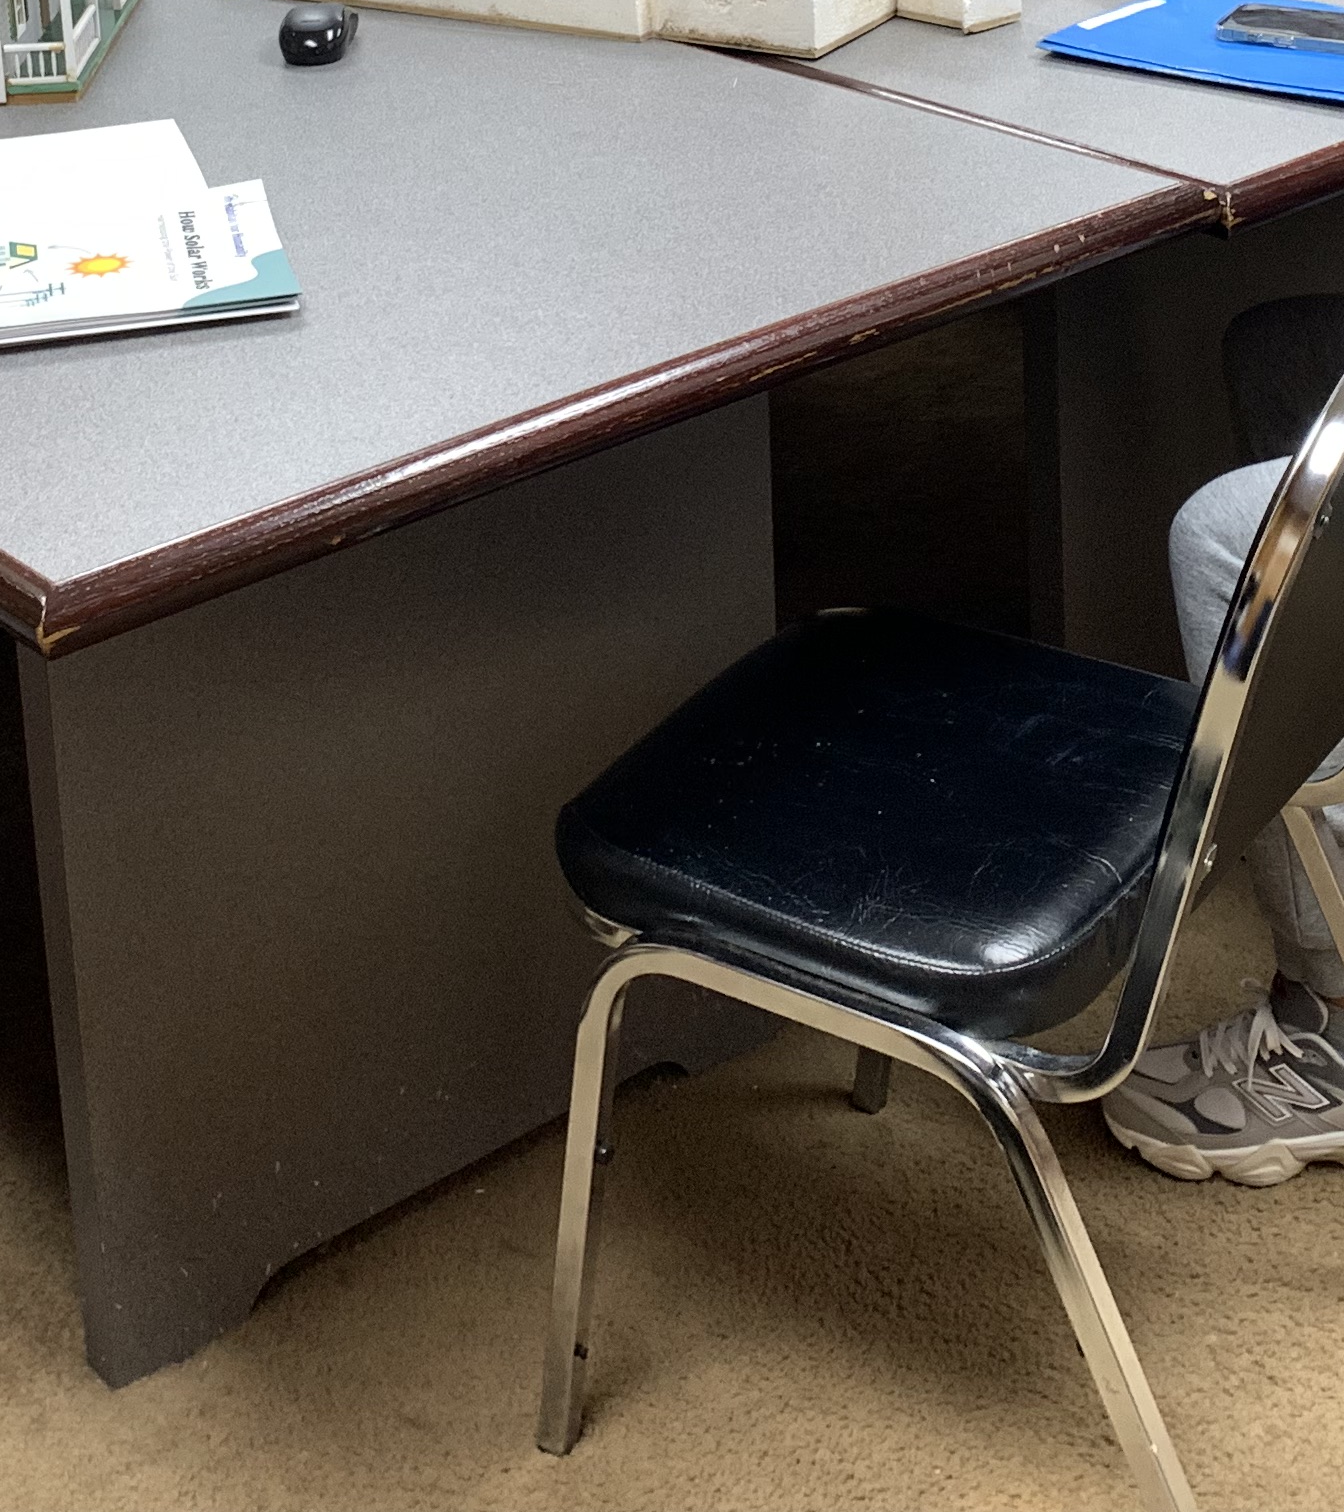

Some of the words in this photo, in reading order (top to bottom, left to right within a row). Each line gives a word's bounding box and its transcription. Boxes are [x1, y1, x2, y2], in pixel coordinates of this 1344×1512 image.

[178, 211, 196, 234] How
[183, 234, 205, 259] Solar
[191, 261, 213, 290] Works
